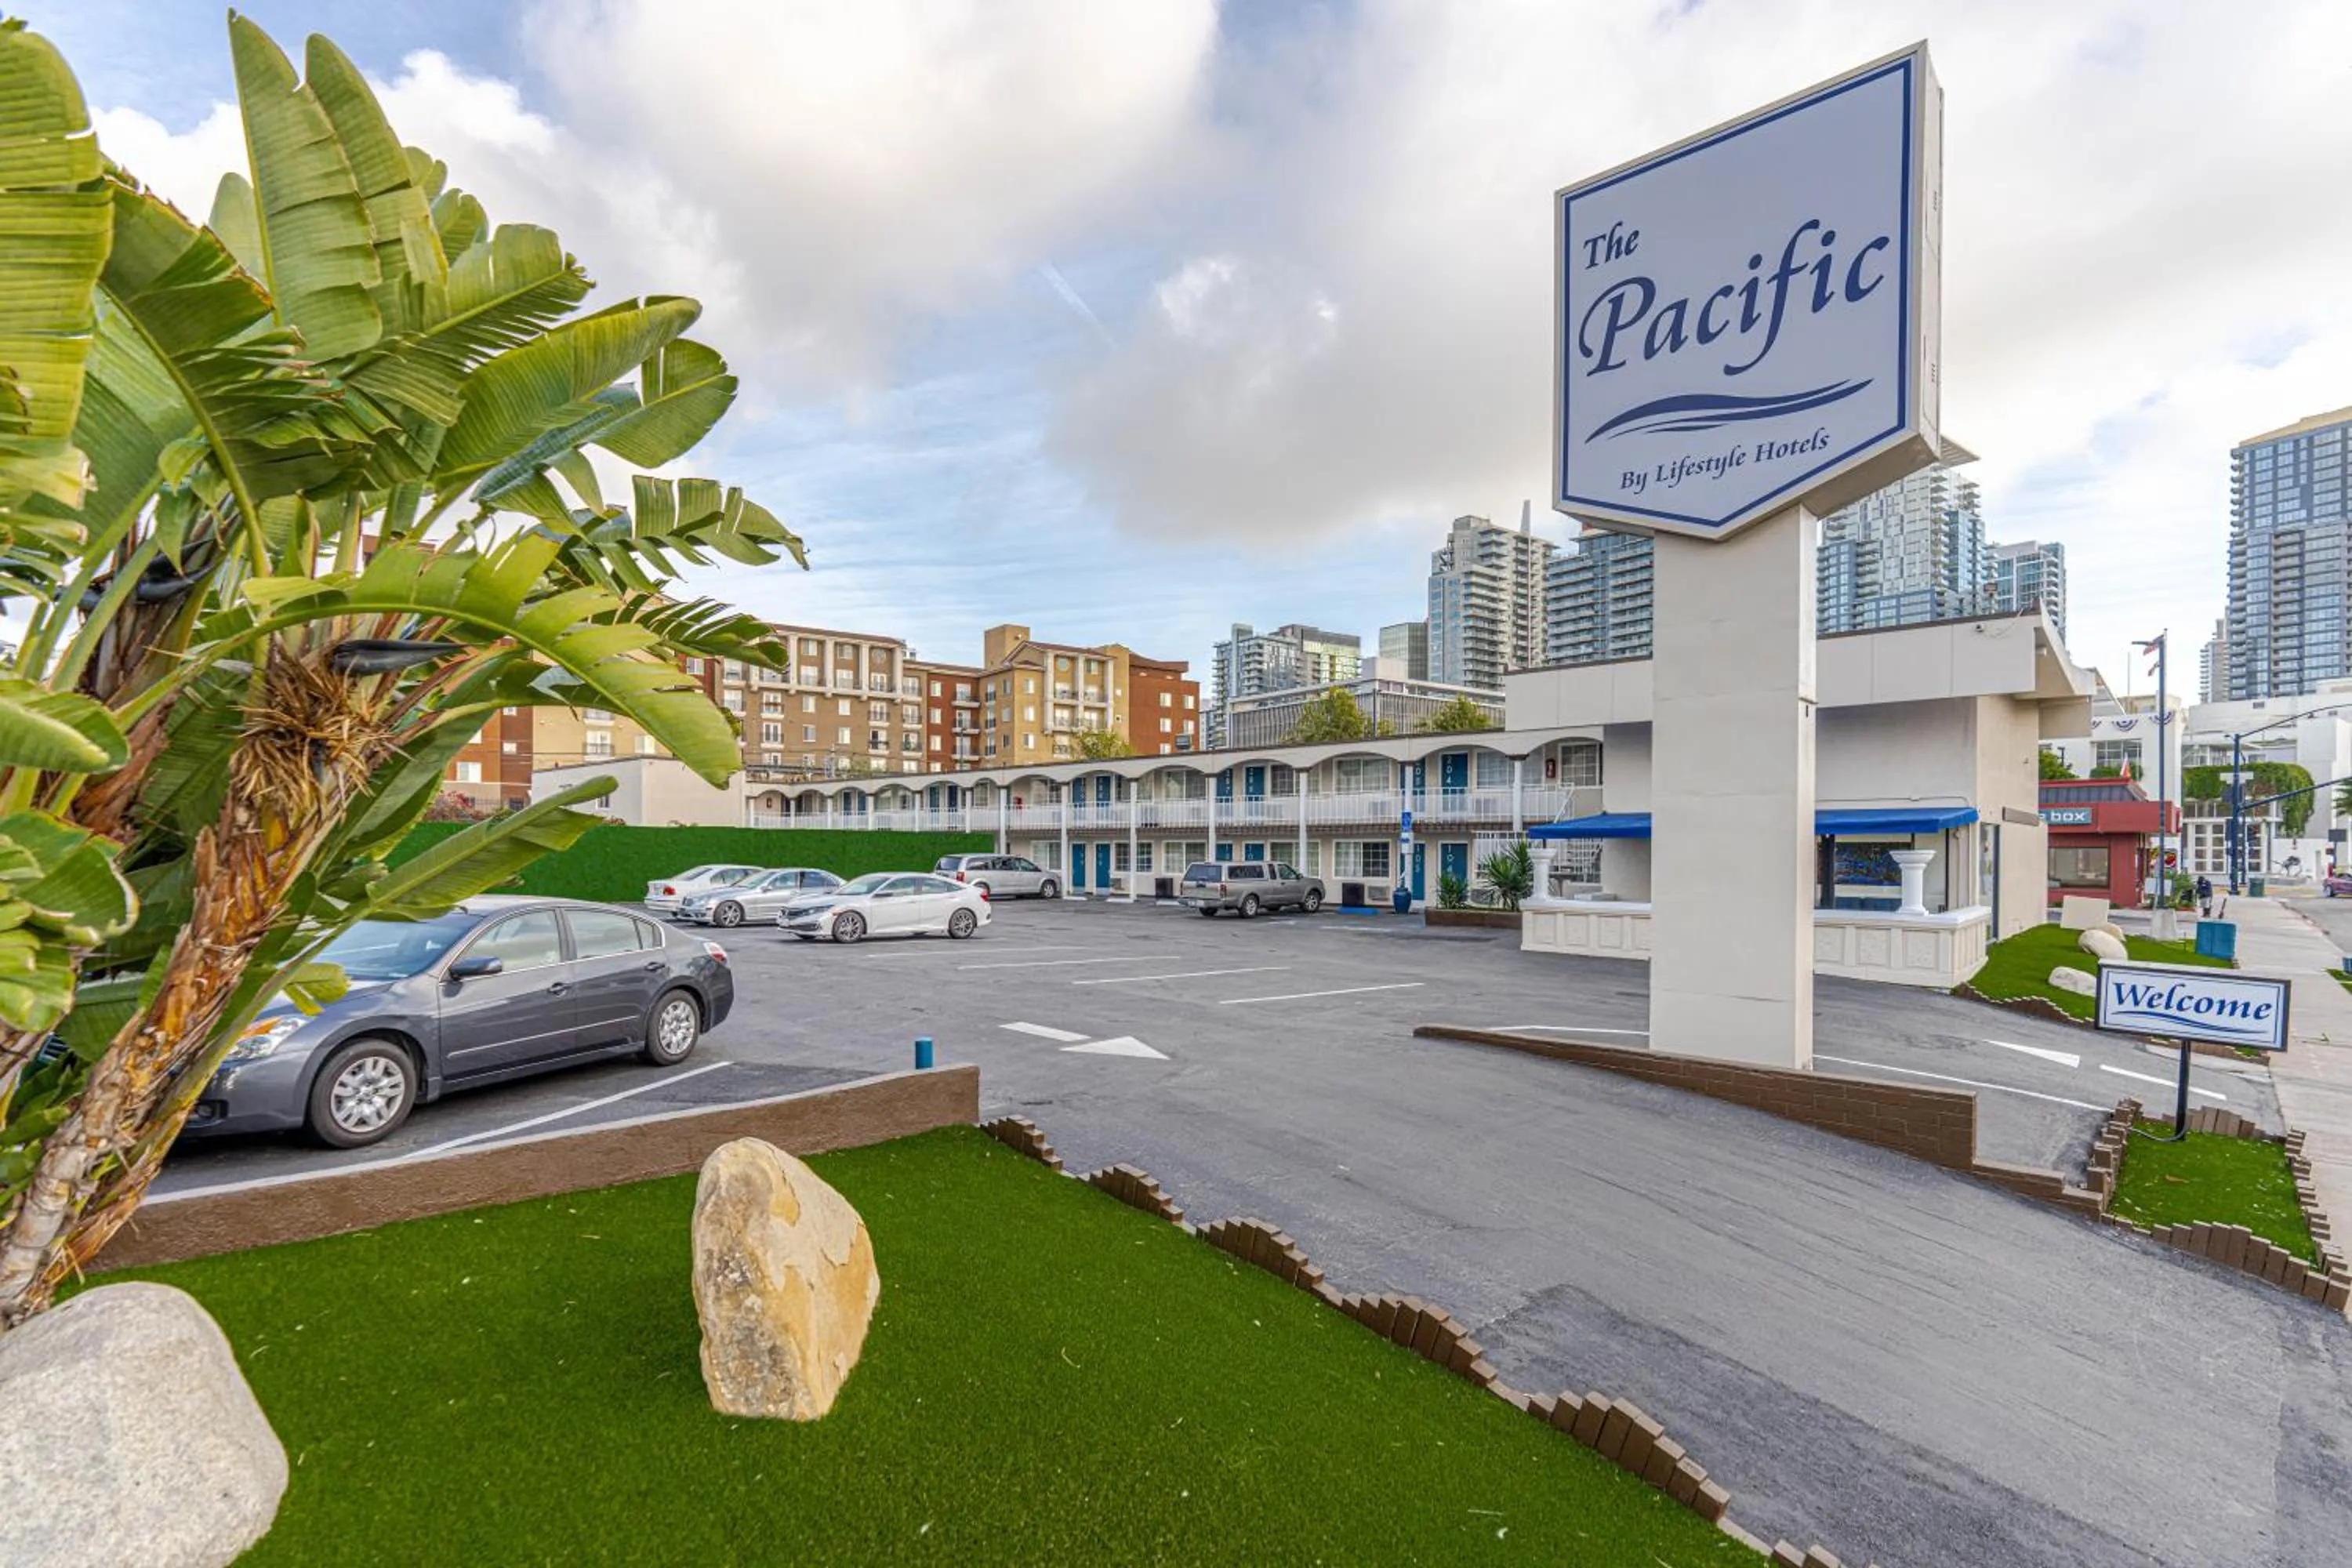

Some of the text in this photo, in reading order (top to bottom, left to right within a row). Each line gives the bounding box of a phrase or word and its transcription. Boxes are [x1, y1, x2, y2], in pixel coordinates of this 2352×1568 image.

[1583, 220, 1640, 270] The
[1578, 219, 1890, 376] Pacific
[1620, 426, 1831, 495] By Lifestyle Hotels
[2050, 809, 2085, 822] box
[2113, 982, 2273, 1020] Welcome
